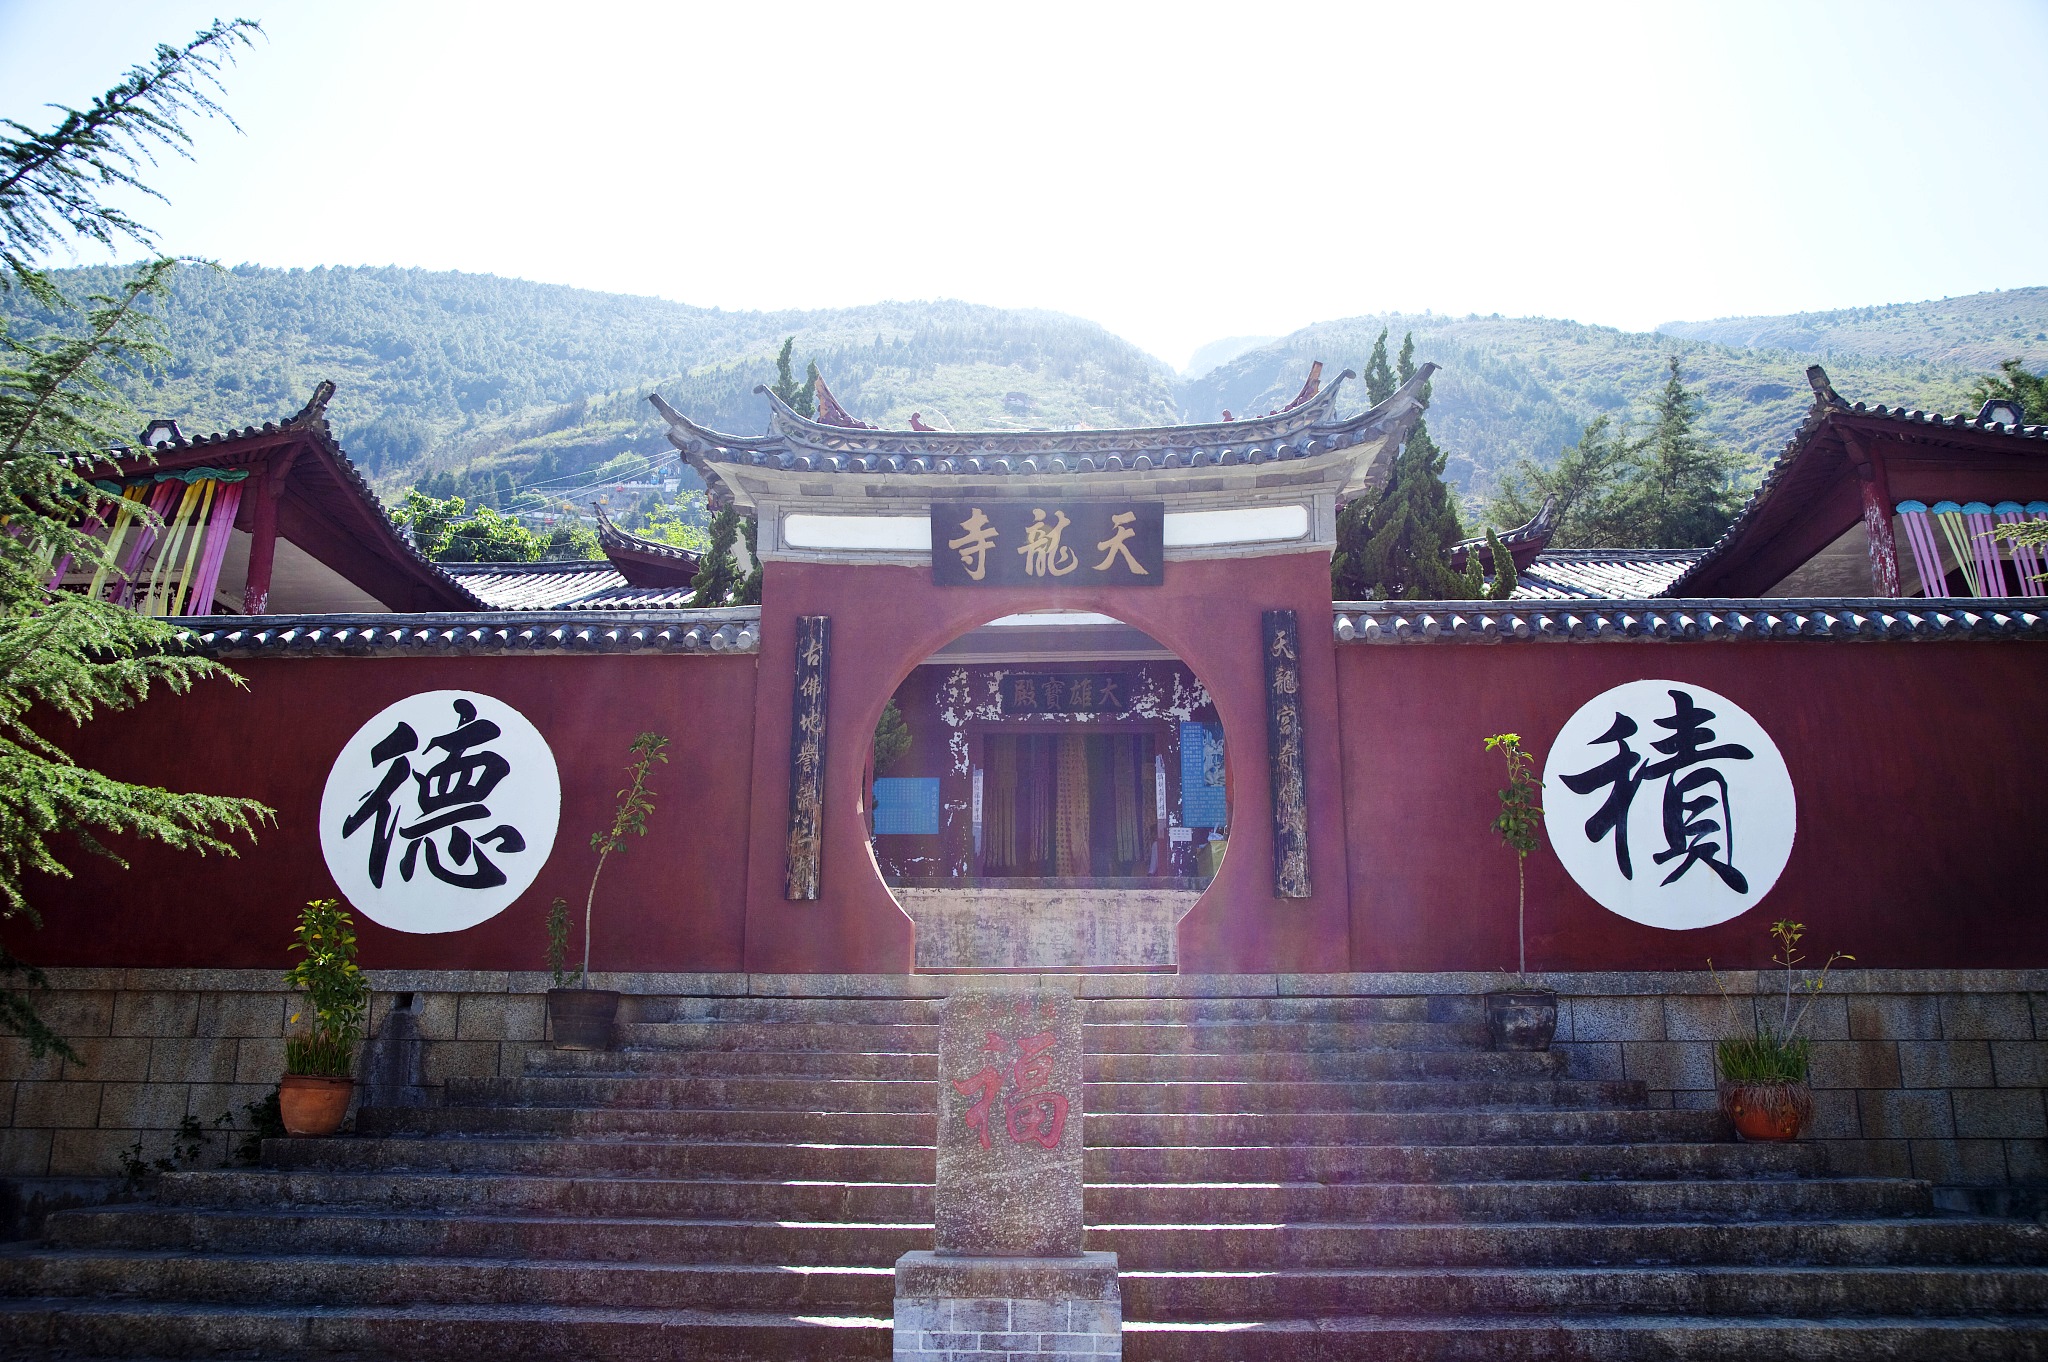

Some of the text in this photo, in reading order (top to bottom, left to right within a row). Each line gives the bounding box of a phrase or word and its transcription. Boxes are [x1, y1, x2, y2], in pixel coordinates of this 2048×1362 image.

[948, 508, 1149, 581] 天龍寺
[342, 698, 527, 890] 德
[1558, 689, 1755, 895] 積
[952, 1030, 1069, 1151] 福
